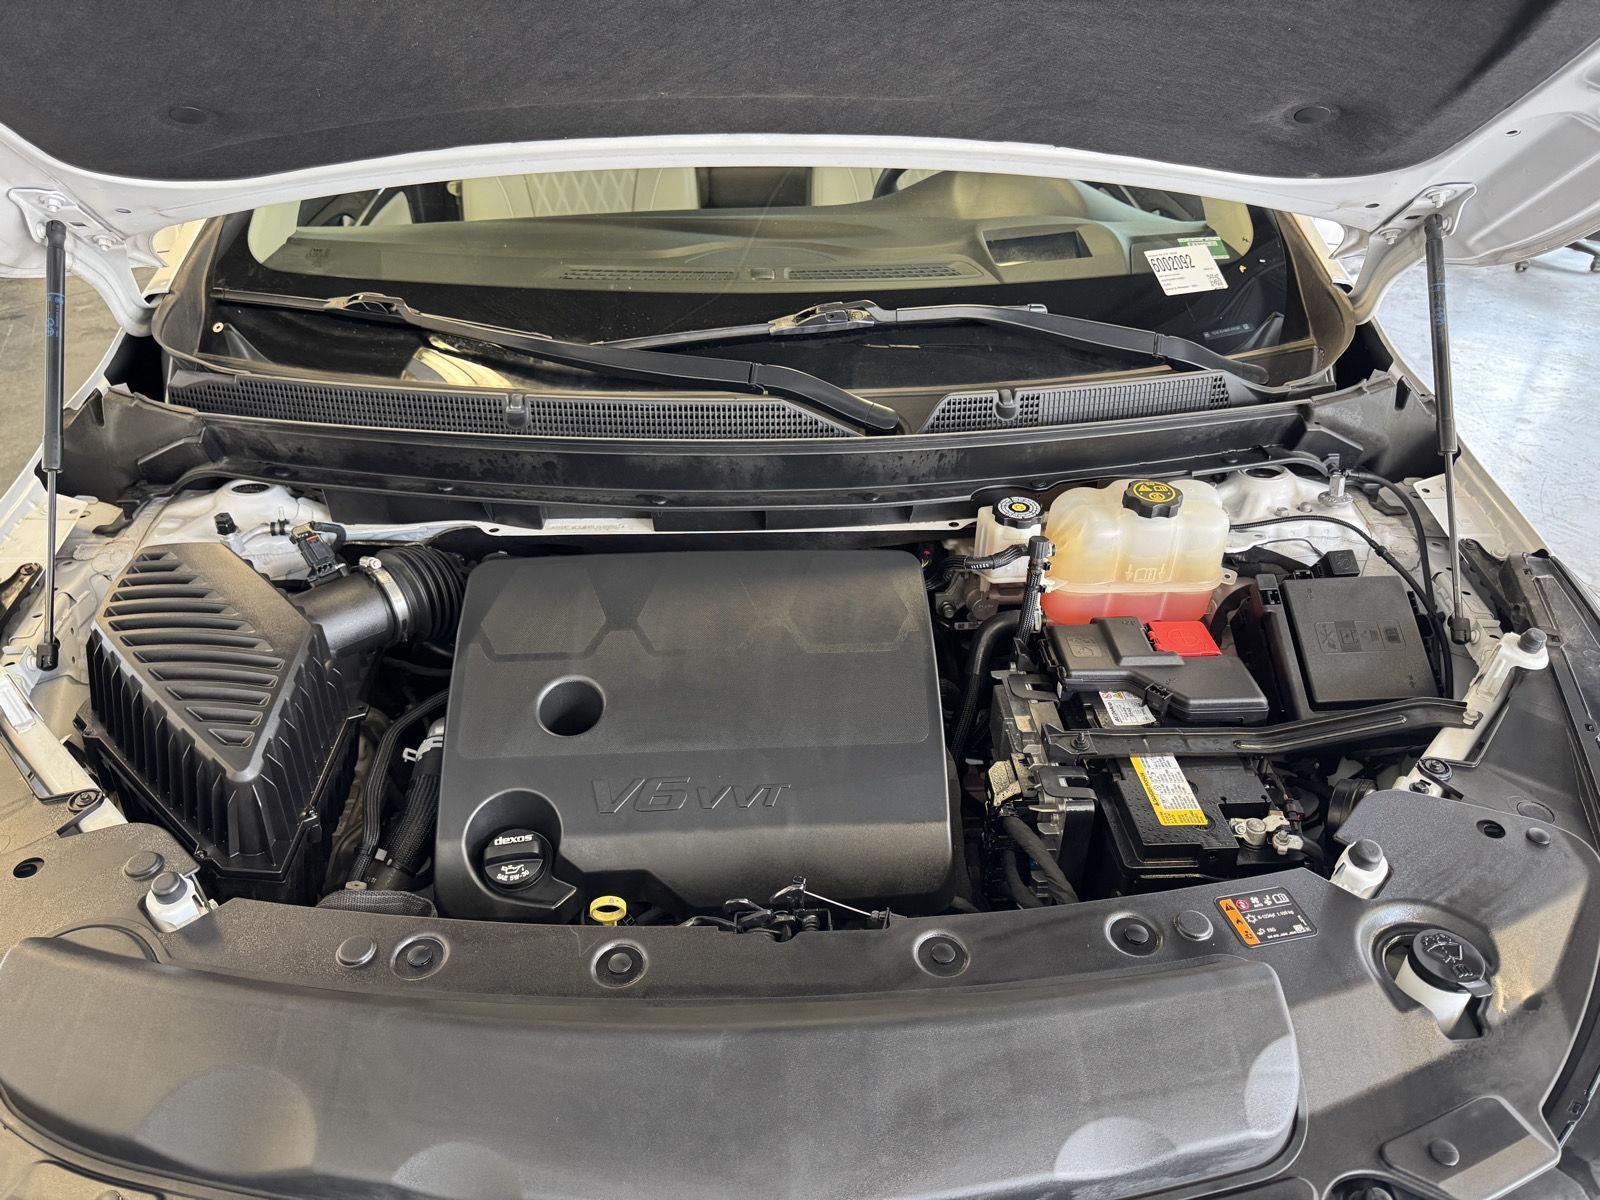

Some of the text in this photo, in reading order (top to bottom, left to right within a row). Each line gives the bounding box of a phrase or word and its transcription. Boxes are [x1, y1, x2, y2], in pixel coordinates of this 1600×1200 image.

[1150, 254, 1196, 273] 6002092
[591, 775, 792, 814] V6 VVT
[494, 834, 534, 846] dexos
[496, 869, 530, 881] SAE 5W-30
